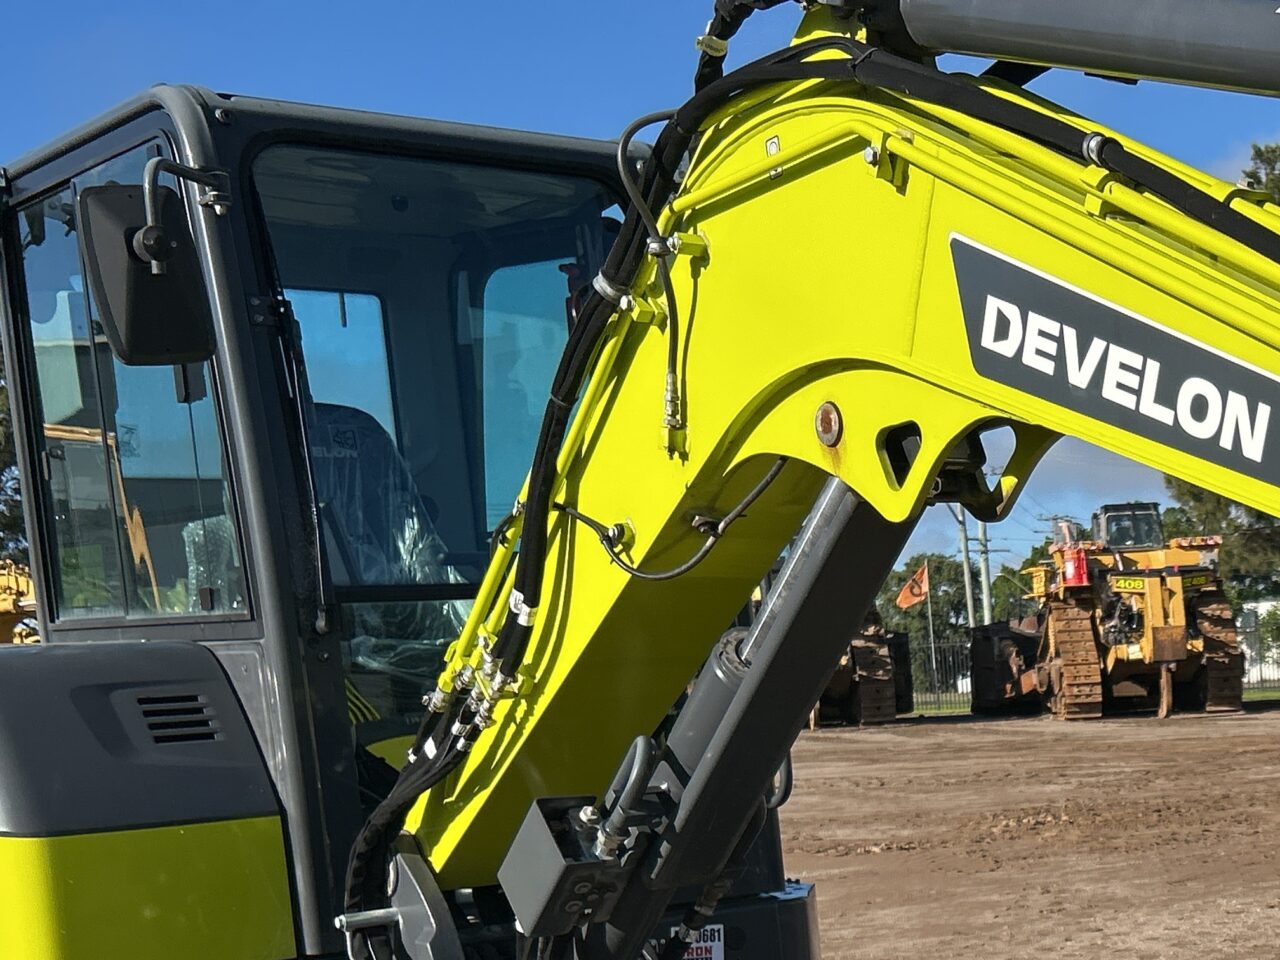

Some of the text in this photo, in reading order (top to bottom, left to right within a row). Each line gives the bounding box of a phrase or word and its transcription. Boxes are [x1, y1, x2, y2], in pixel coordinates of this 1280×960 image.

[980, 294, 1272, 464] DEVELON
[1115, 579, 1144, 589] 408
[682, 946, 713, 958] RON
